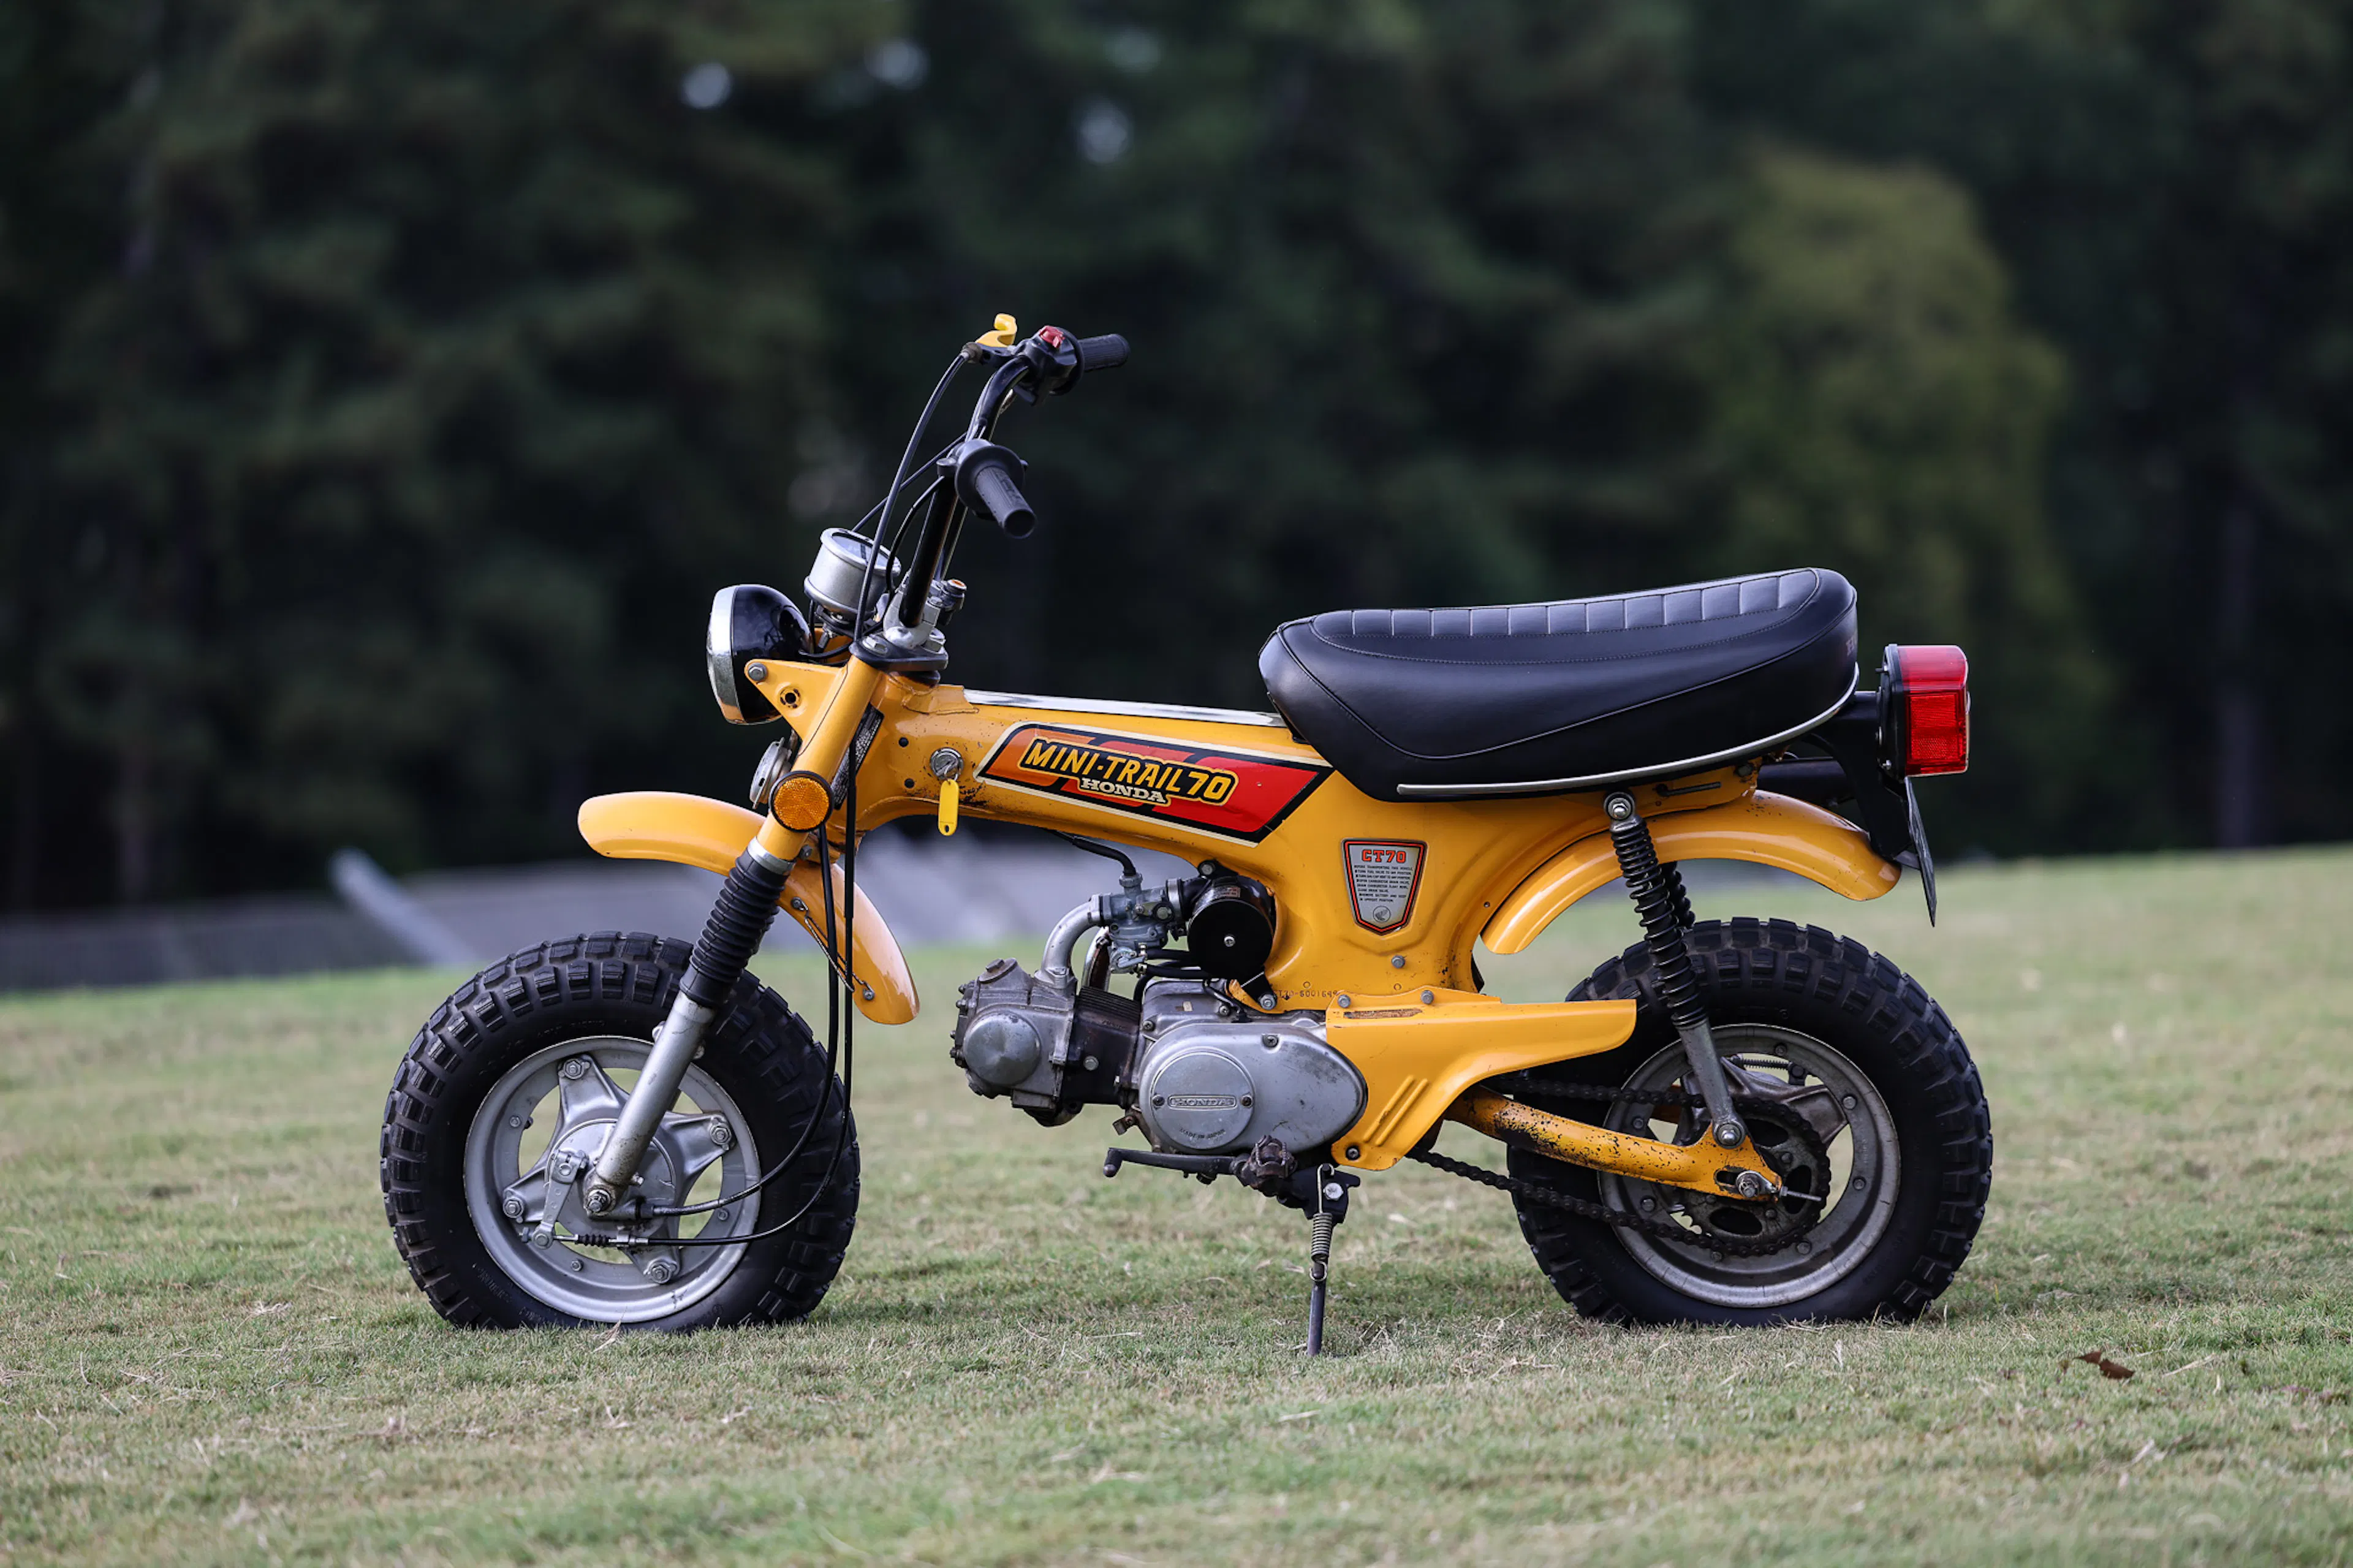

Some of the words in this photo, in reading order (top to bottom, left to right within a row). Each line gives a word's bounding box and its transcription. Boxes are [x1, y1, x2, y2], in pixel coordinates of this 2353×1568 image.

[1080, 777, 1166, 803] HONDA
[1186, 771, 1232, 800] 70
[1362, 849, 1406, 863] CT70
[1176, 1097, 1229, 1106] HONDA
